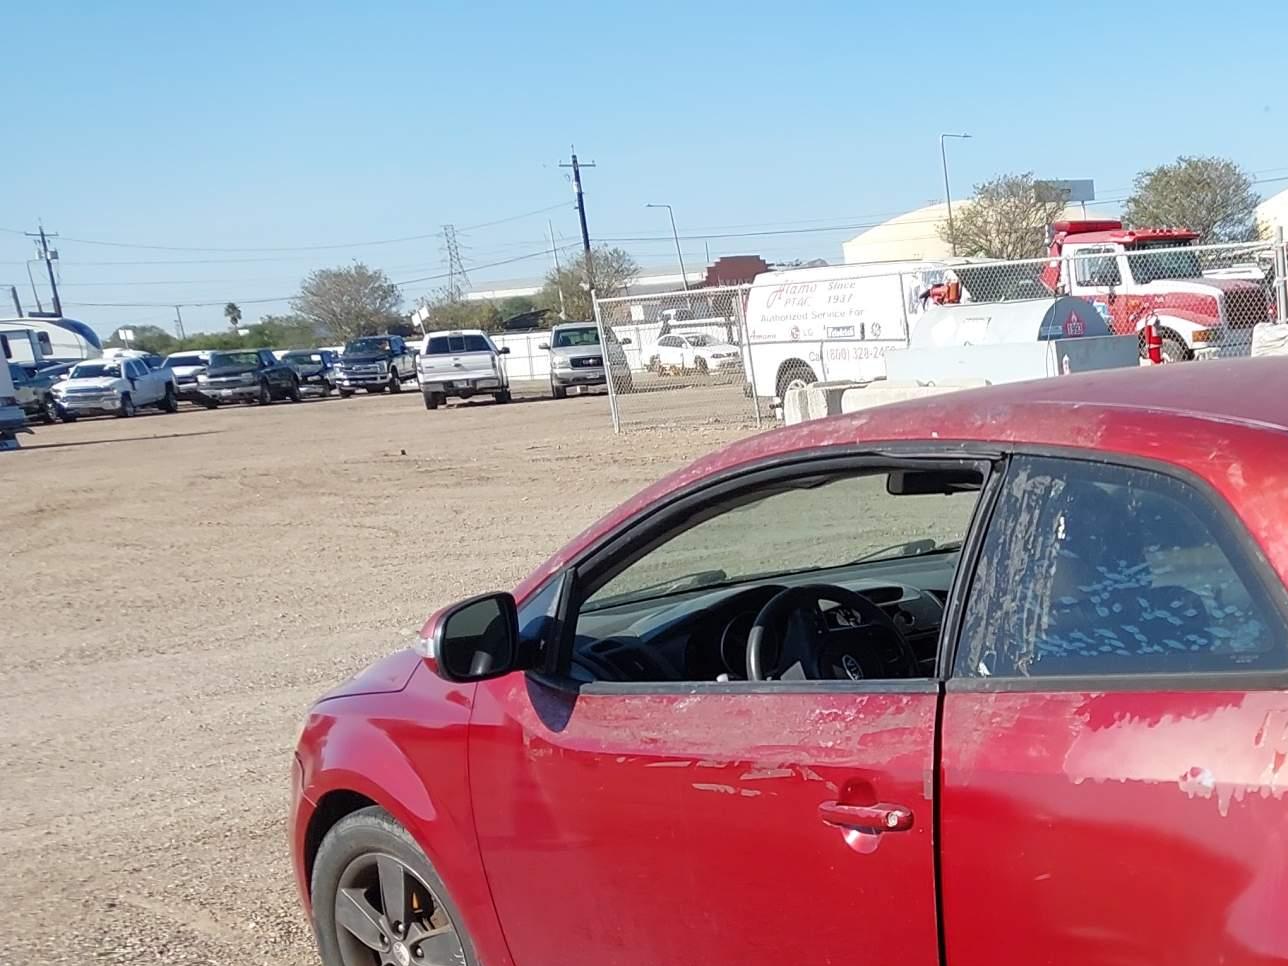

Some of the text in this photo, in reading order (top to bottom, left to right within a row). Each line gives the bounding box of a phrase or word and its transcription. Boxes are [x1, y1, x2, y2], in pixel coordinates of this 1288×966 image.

[828, 281, 856, 290] Since
[761, 307, 865, 322] Authorized Service For
